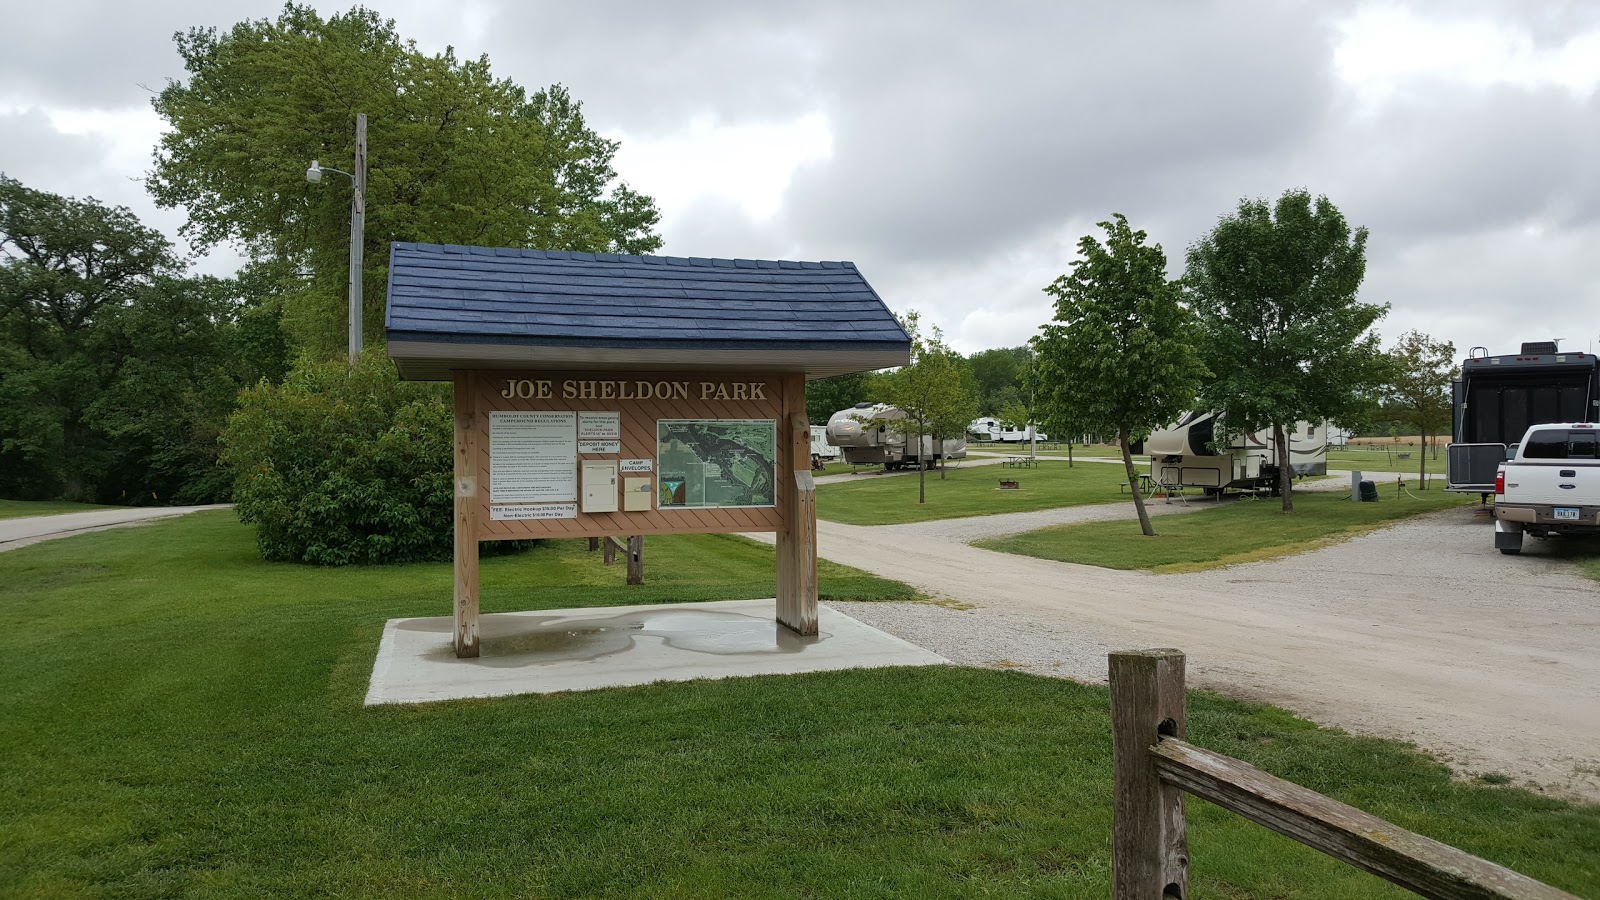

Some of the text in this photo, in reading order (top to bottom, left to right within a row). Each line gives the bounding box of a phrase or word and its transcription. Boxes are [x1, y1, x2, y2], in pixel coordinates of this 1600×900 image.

[501, 379, 767, 400] JOE SHELDON PARK
